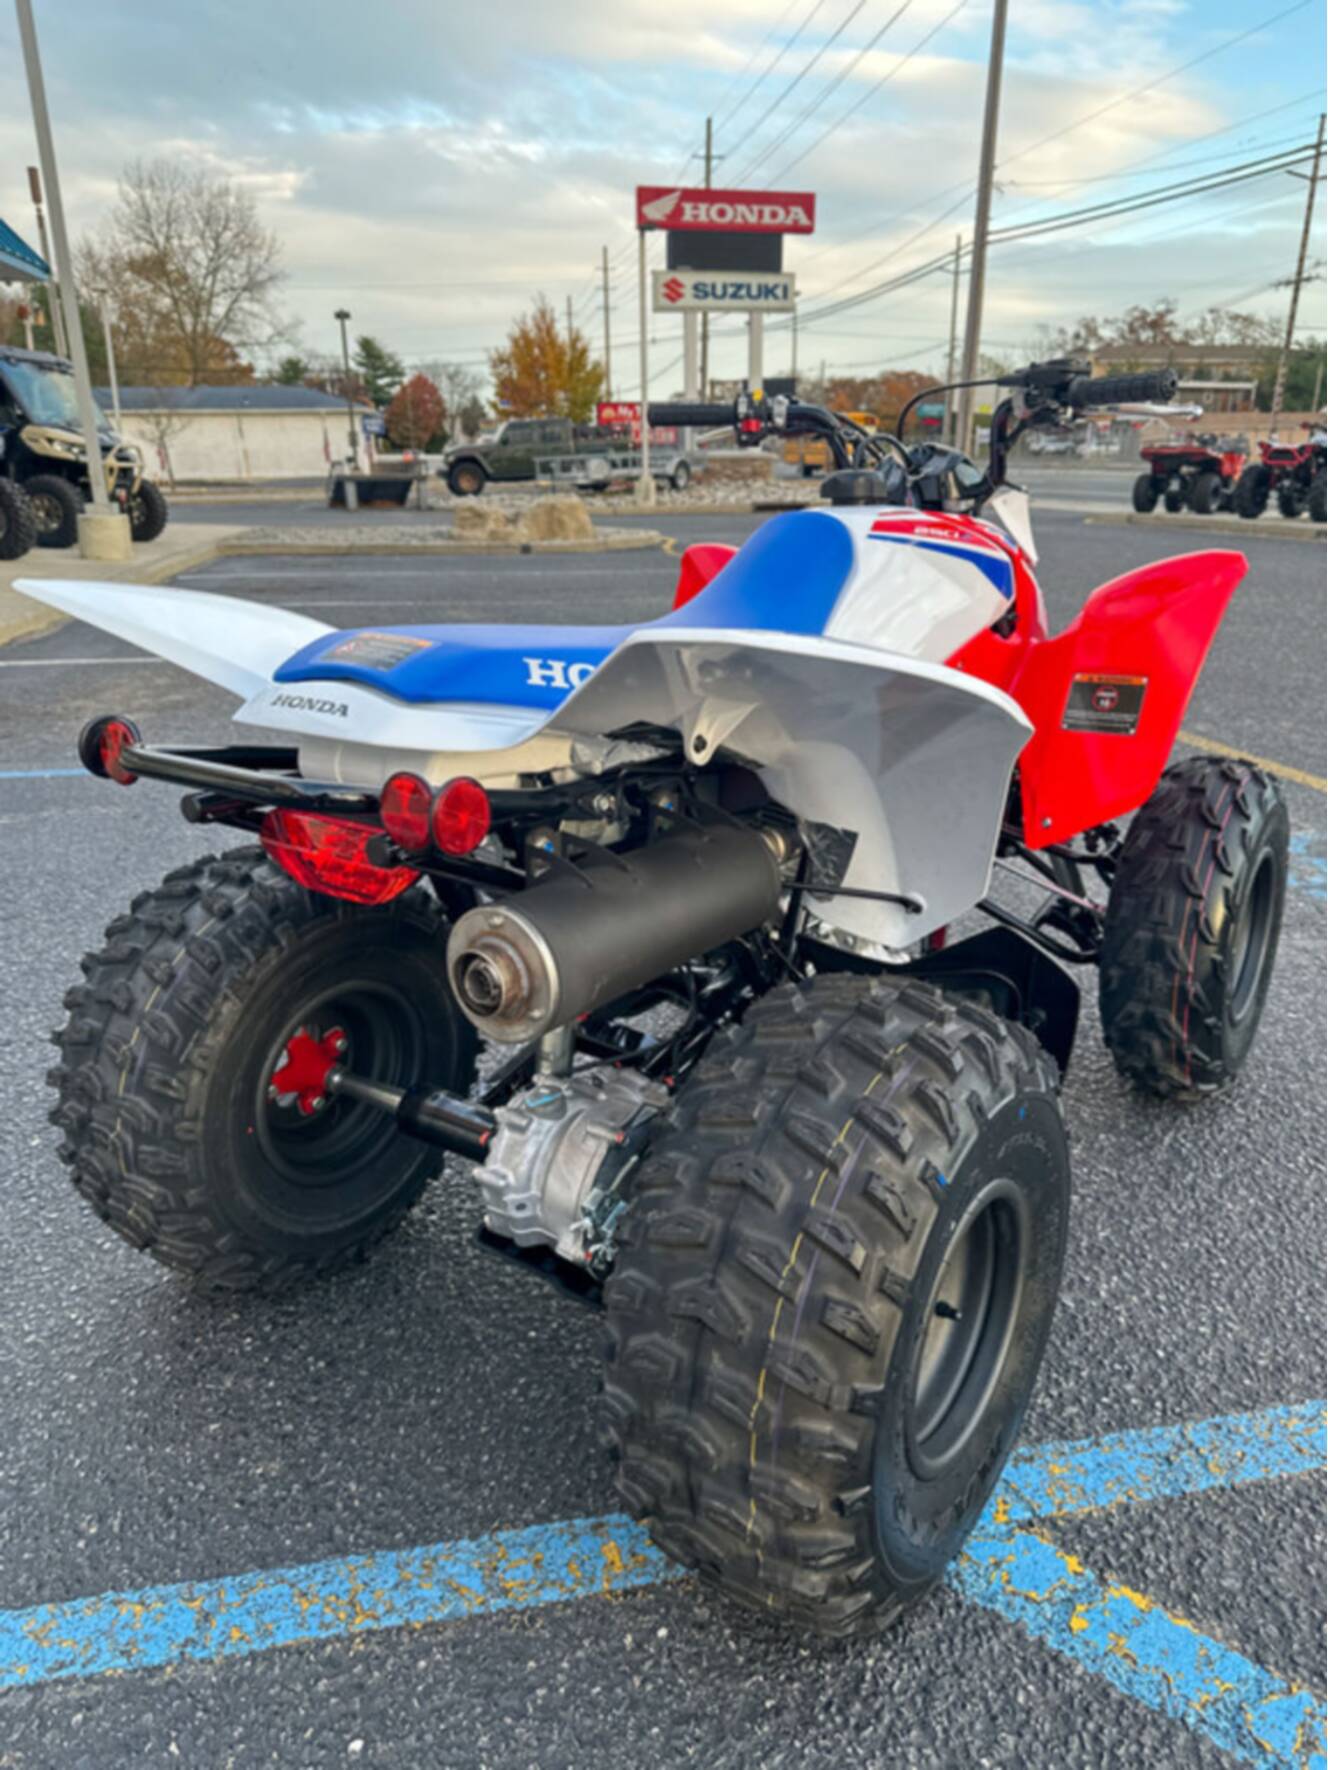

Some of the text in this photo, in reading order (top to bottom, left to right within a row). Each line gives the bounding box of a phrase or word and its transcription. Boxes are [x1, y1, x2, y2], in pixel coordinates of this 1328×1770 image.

[681, 202, 811, 226] HONDA
[692, 282, 789, 300] SUZUKI
[270, 693, 349, 717] HONDA
